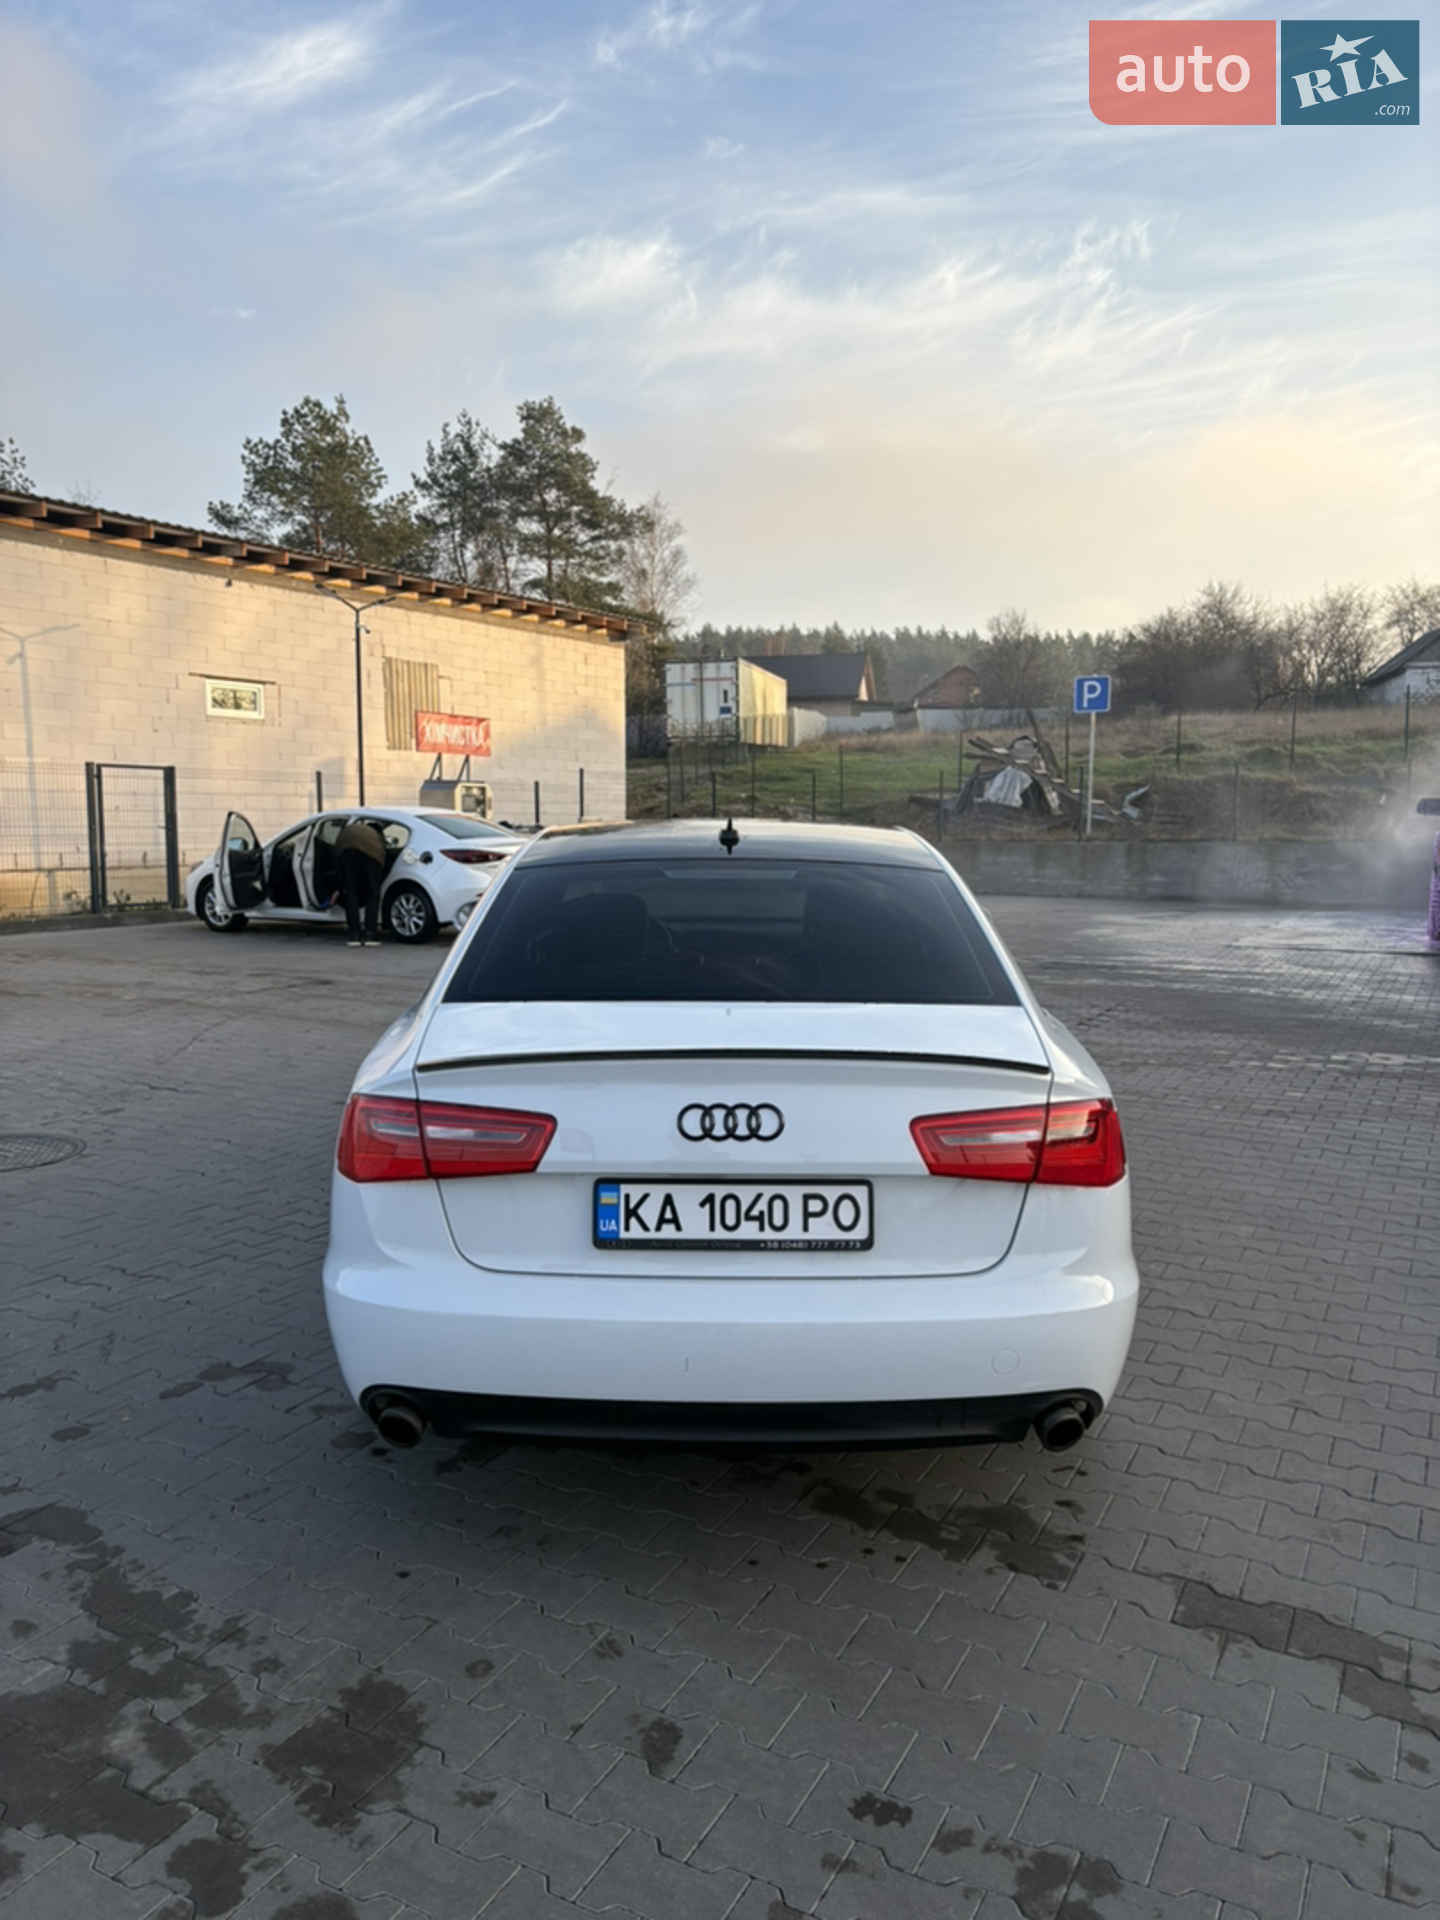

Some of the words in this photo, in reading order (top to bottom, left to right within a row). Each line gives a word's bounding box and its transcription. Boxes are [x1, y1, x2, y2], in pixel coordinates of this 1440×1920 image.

[1083, 681, 1101, 708] P
[600, 1219, 617, 1231] UA
[624, 1192, 683, 1232] KA
[698, 1192, 789, 1232] 1040
[802, 1193, 861, 1232] PO
